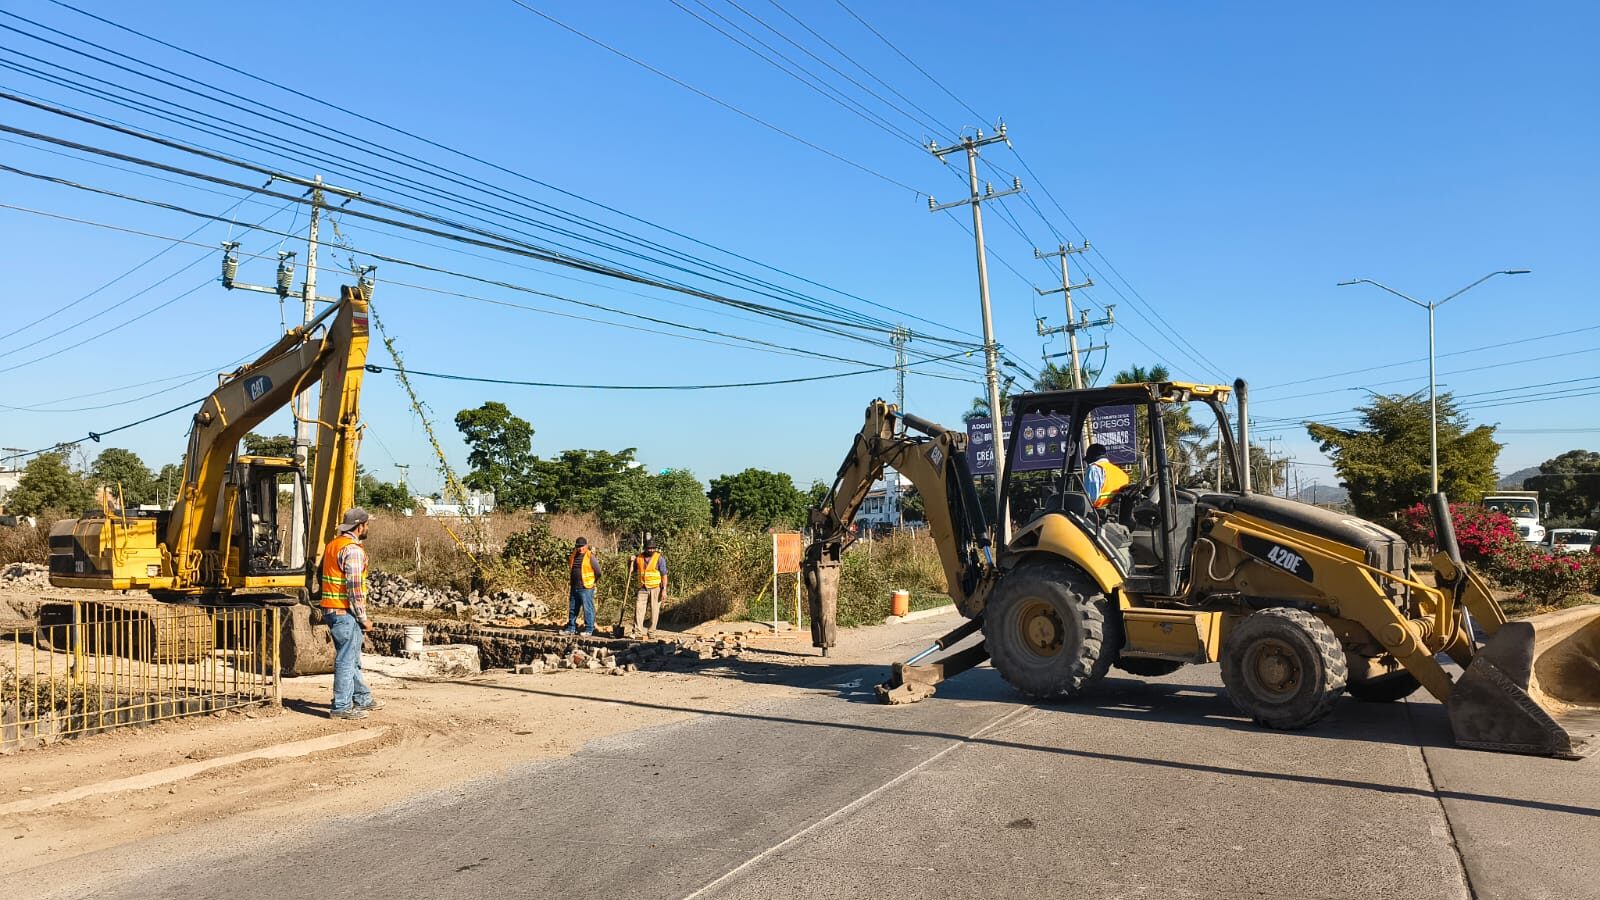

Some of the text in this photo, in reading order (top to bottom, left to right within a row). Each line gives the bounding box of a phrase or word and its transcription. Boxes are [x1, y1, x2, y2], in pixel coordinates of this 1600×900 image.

[251, 377, 264, 401] CAT
[1100, 418, 1130, 429] PESOS
[931, 446, 943, 465] CAT
[1267, 545, 1303, 573] 420E
